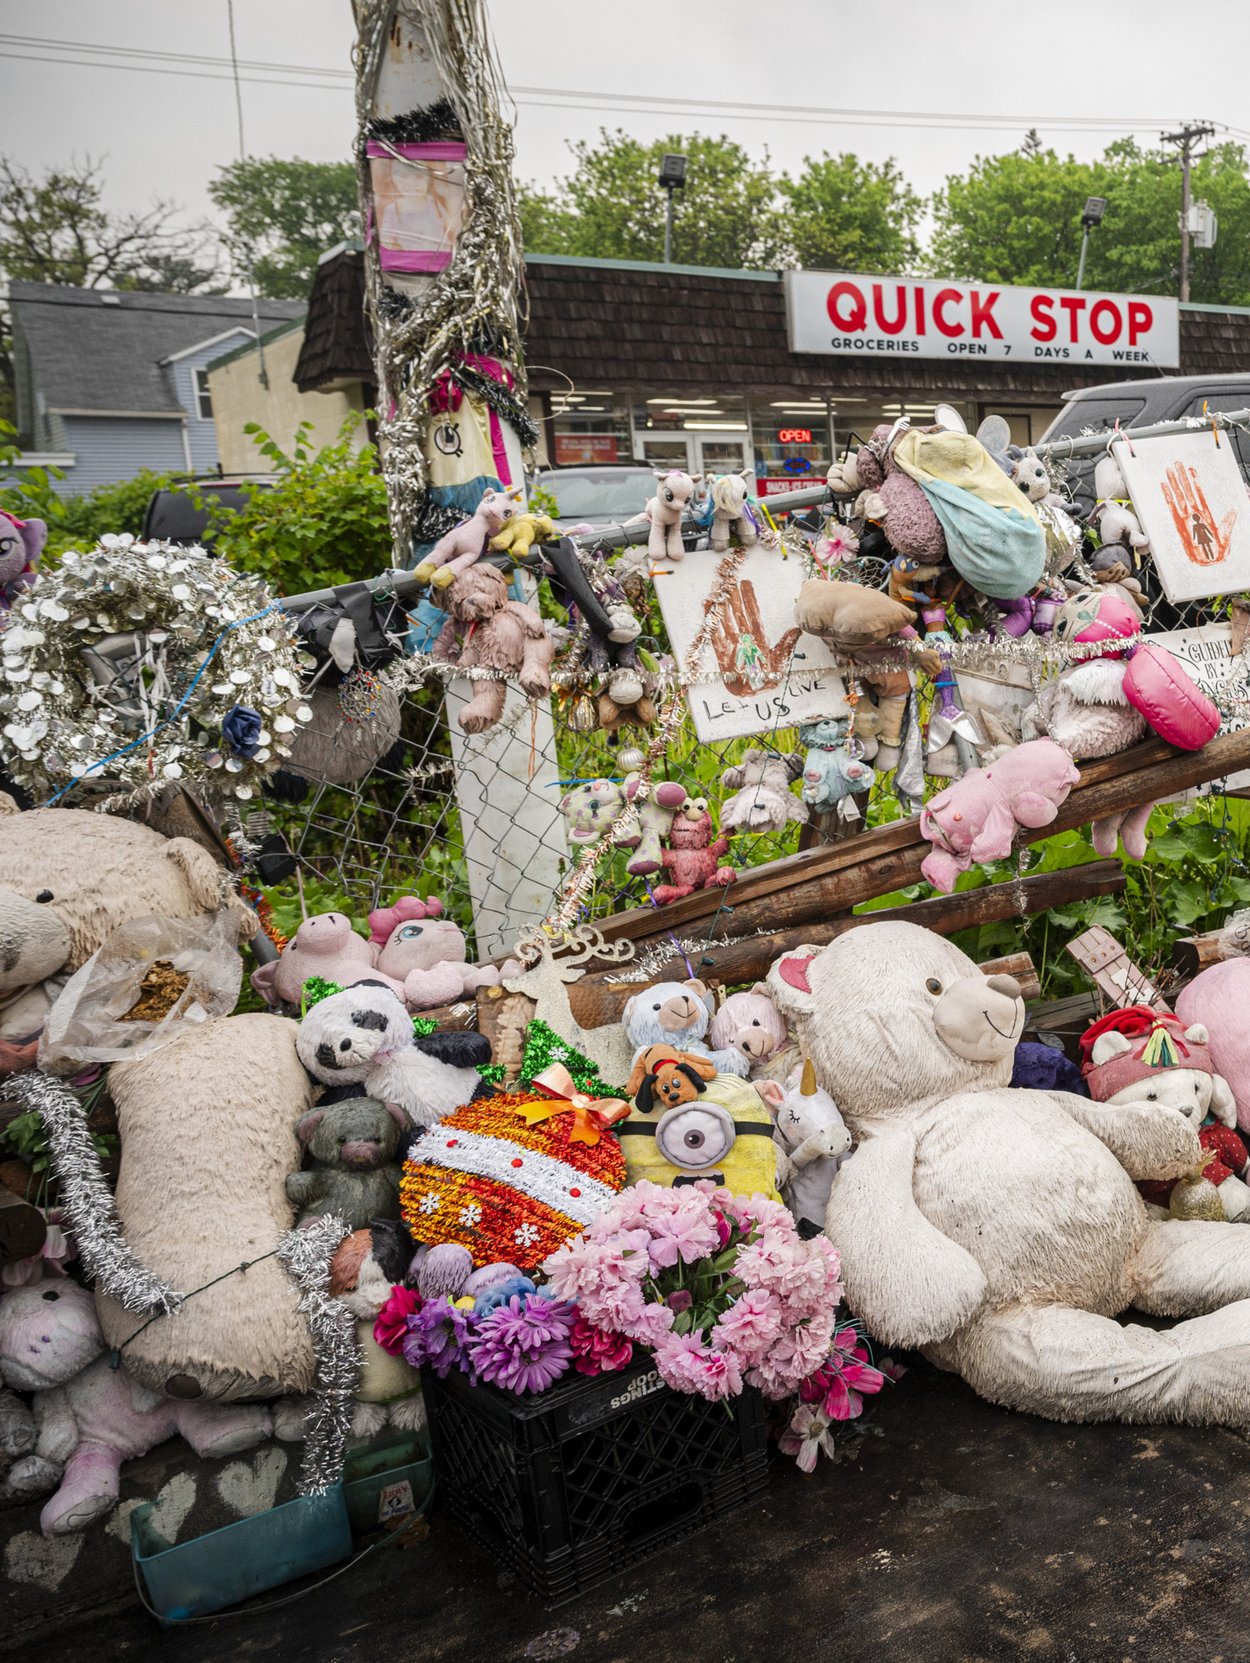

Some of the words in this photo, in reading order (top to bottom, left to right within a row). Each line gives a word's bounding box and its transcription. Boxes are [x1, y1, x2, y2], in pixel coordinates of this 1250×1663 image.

[826, 281, 1004, 340] QUICK
[1030, 294, 1153, 346] STOP
[831, 337, 919, 352] GROCERIES
[947, 342, 988, 355] OPEN
[1004, 345, 1012, 355] 7
[1034, 346, 1070, 359] DAYS
[1085, 349, 1094, 360] A
[1112, 350, 1149, 362] WEEK
[779, 429, 811, 443] OPEN
[1204, 662, 1218, 680] BY
[755, 697, 790, 721] US
[627, 1370, 658, 1391] OOP
[610, 1377, 666, 1409] STINGS
